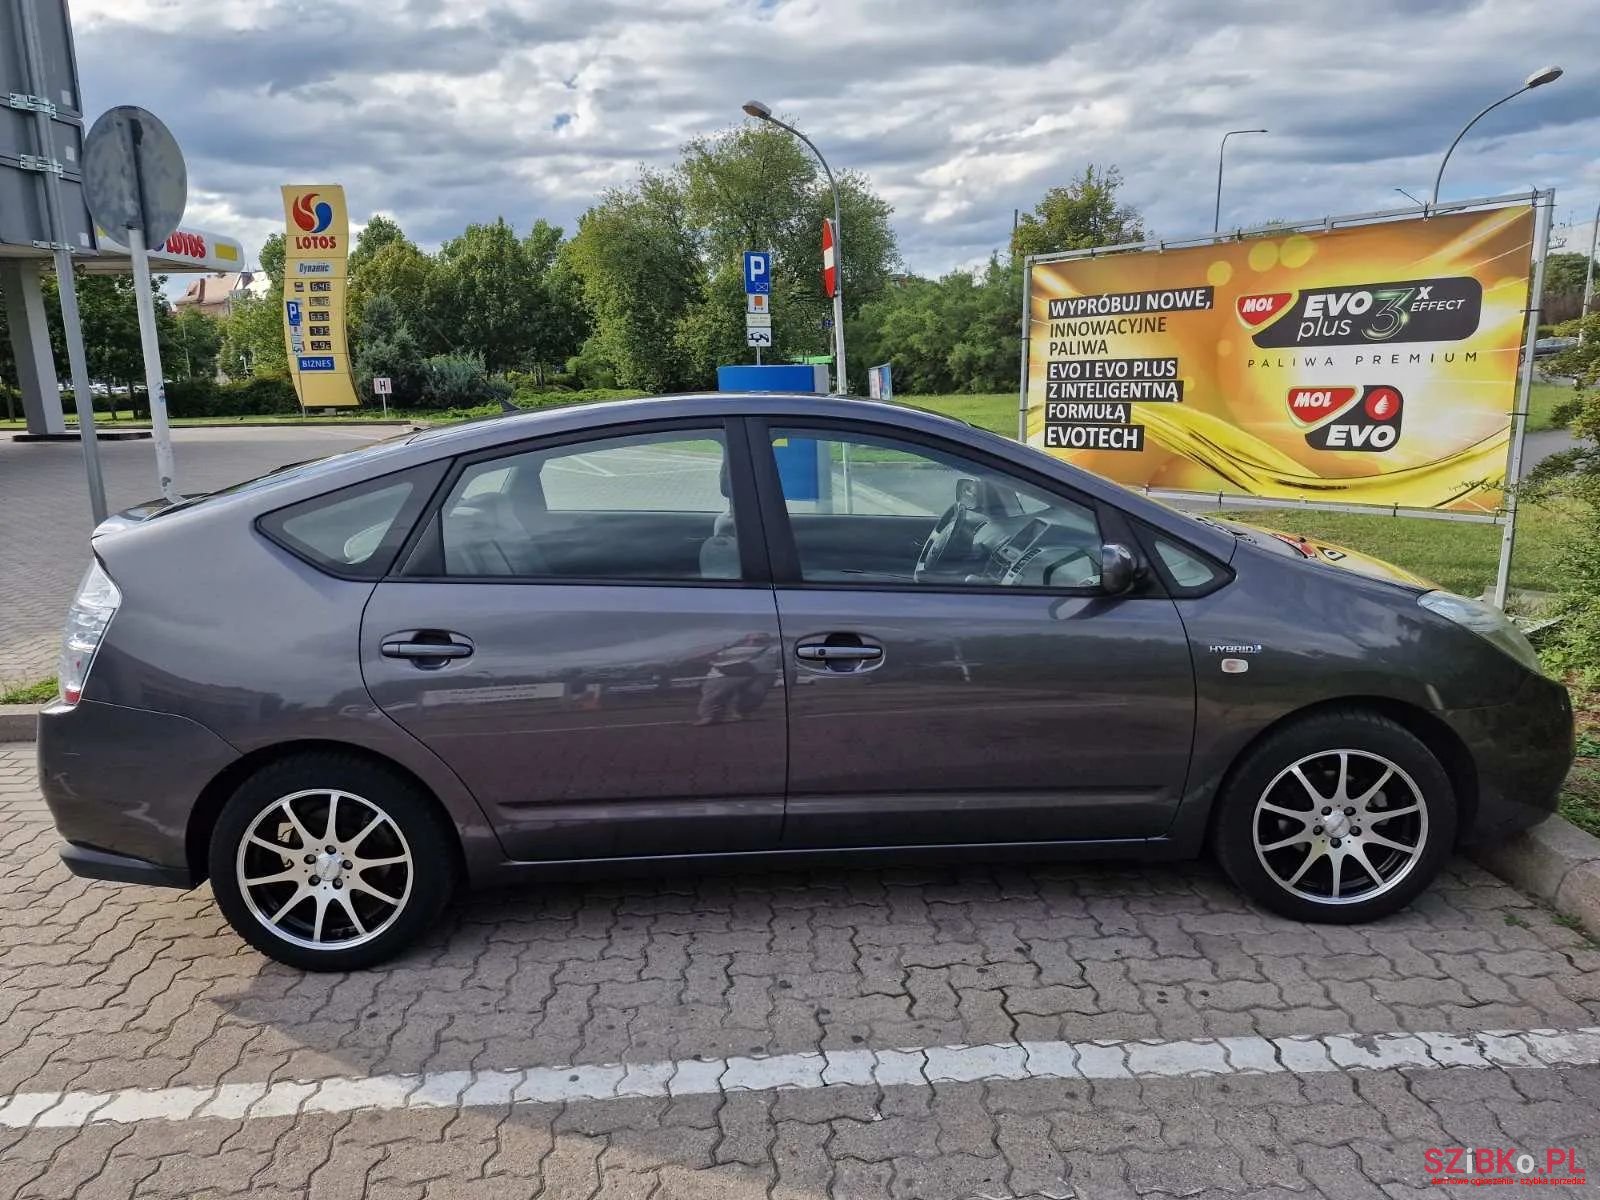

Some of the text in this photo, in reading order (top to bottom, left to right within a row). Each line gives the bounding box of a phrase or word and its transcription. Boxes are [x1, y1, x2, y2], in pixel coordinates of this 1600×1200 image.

[167, 232, 206, 258] LOTOS
[296, 236, 336, 249] LOTOS
[299, 263, 330, 274] Dynamic
[750, 256, 765, 281] P
[1051, 289, 1211, 317] WYPRÓBUJ NOWE,
[1242, 297, 1273, 313] MOL
[1303, 290, 1373, 318] EVO
[1410, 299, 1465, 312] EFFECT
[1050, 317, 1167, 338] INNOWACYJNE
[1297, 316, 1352, 341] plus
[1050, 340, 1108, 356] PALIWA
[302, 360, 332, 368] BIZNES
[1050, 360, 1176, 379] EVO I EVO PLUS
[1248, 352, 1477, 368] PALIWA PREMIUM
[1049, 382, 1179, 401] Z INTELIGENTNĄ
[1294, 391, 1332, 407] MOL
[1049, 404, 1126, 423] FORMUŁĄ
[1047, 427, 1138, 448] EVOTECH
[1326, 424, 1395, 447] EVO
[1210, 645, 1253, 653] HYBRID
